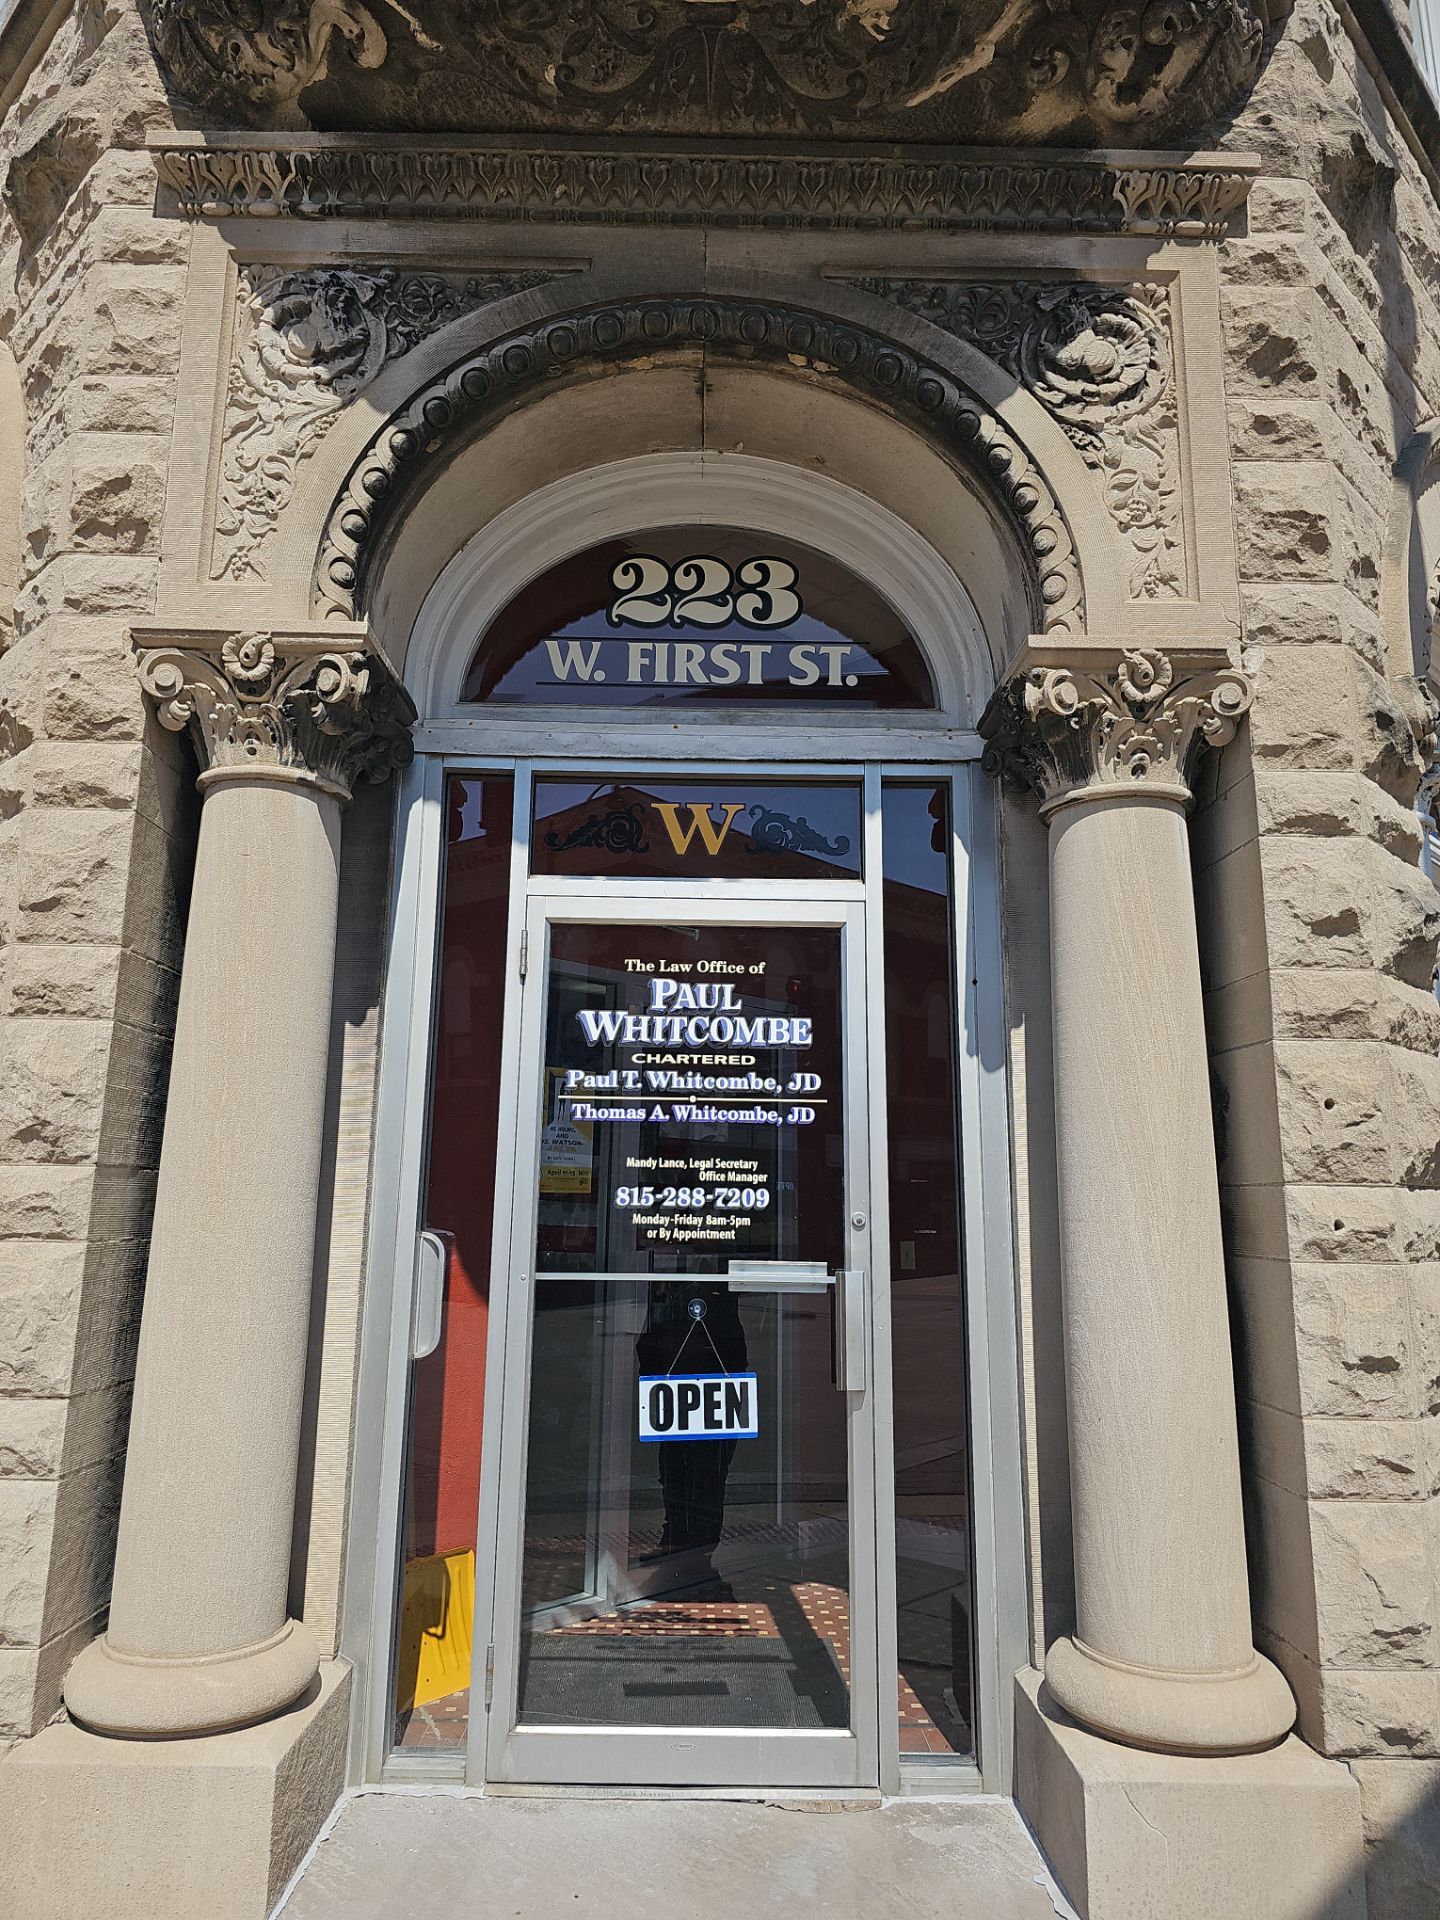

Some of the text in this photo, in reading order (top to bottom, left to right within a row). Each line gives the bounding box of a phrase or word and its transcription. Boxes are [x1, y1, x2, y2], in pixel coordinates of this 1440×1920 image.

[611, 557, 799, 625] 223
[544, 640, 858, 687] W. FIRST ST.
[651, 803, 746, 856] W
[625, 959, 766, 974] The Law Office of
[651, 978, 743, 1011] PAUL
[578, 1010, 813, 1046] WHITCOMBE
[631, 1053, 756, 1066] CHARTERED
[566, 1070, 822, 1093] Paul T. Whitcombe, JD
[571, 1103, 816, 1125] Thomas A. Whitcombe, JD
[626, 1157, 758, 1173] Mandy Lance, Legal Secretary
[699, 1171, 768, 1184] Office Manager
[615, 1187, 770, 1209] 815-288-7209
[632, 1213, 751, 1228] Monday-Friday 8am-5pm
[647, 1228, 736, 1241] or By Appointment
[648, 1382, 750, 1432] OPEN
